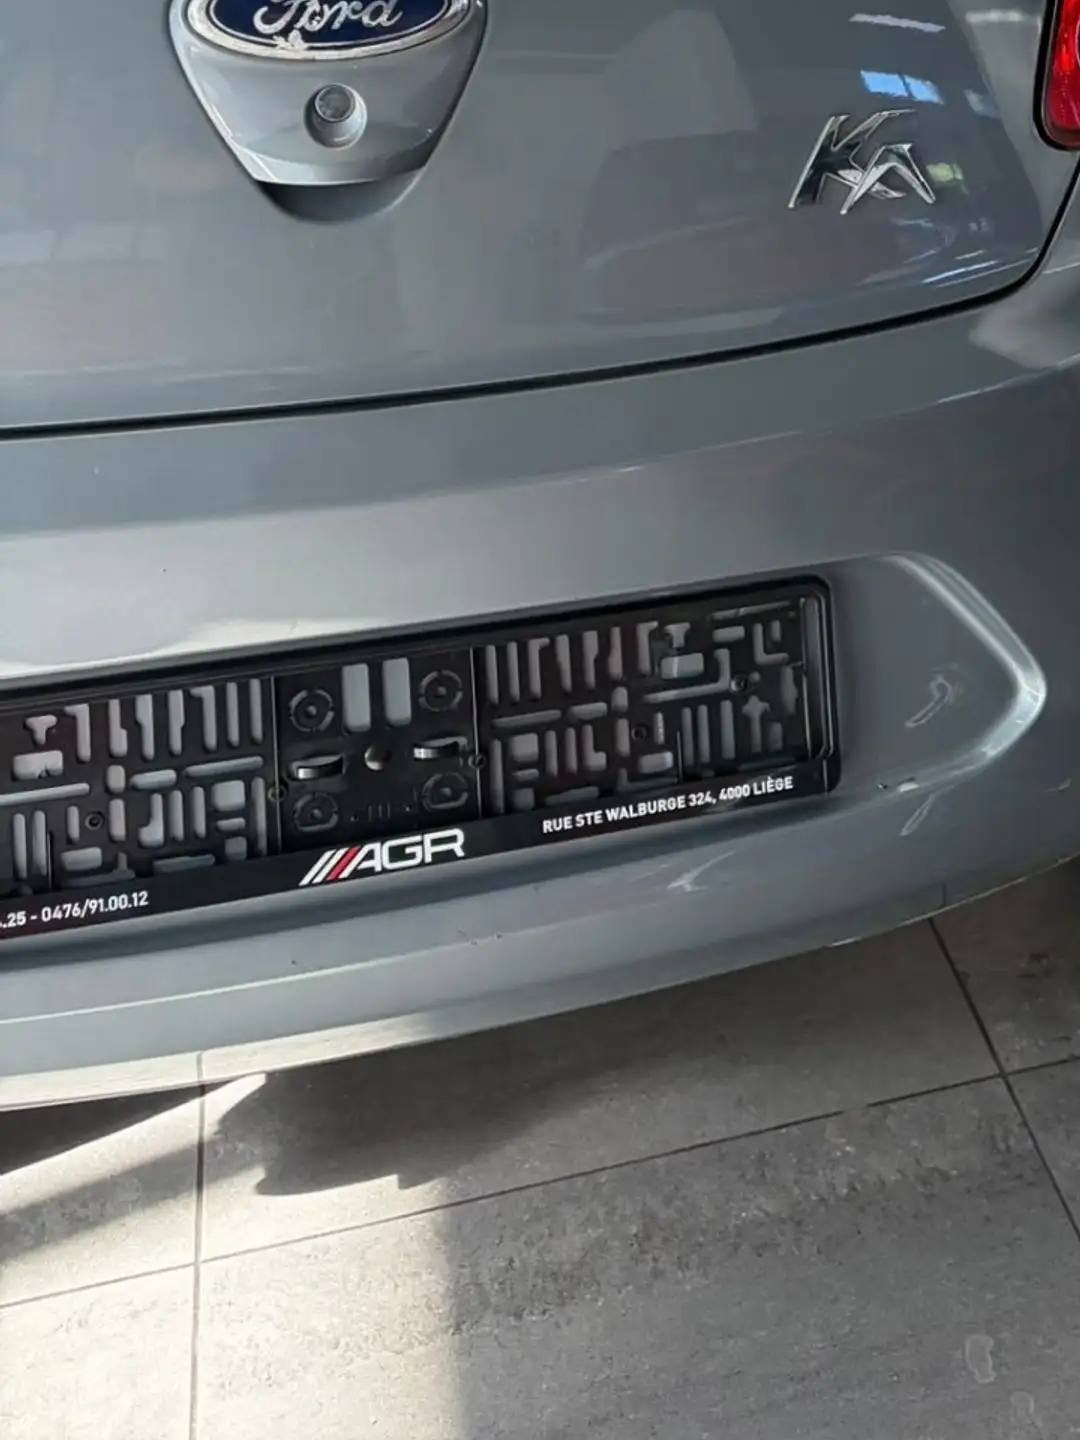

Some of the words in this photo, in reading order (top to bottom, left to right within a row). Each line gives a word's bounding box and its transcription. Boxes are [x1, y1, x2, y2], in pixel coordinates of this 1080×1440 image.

[542, 816, 573, 834] RUE
[575, 809, 603, 828] STE
[605, 794, 687, 822] WALBURGE
[688, 790, 717, 806] 324,
[718, 784, 751, 801] 4000
[752, 776, 795, 796] LIÈGE
[0, 910, 27, 929] .25
[41, 890, 149, 923] 0476/91.00.12
